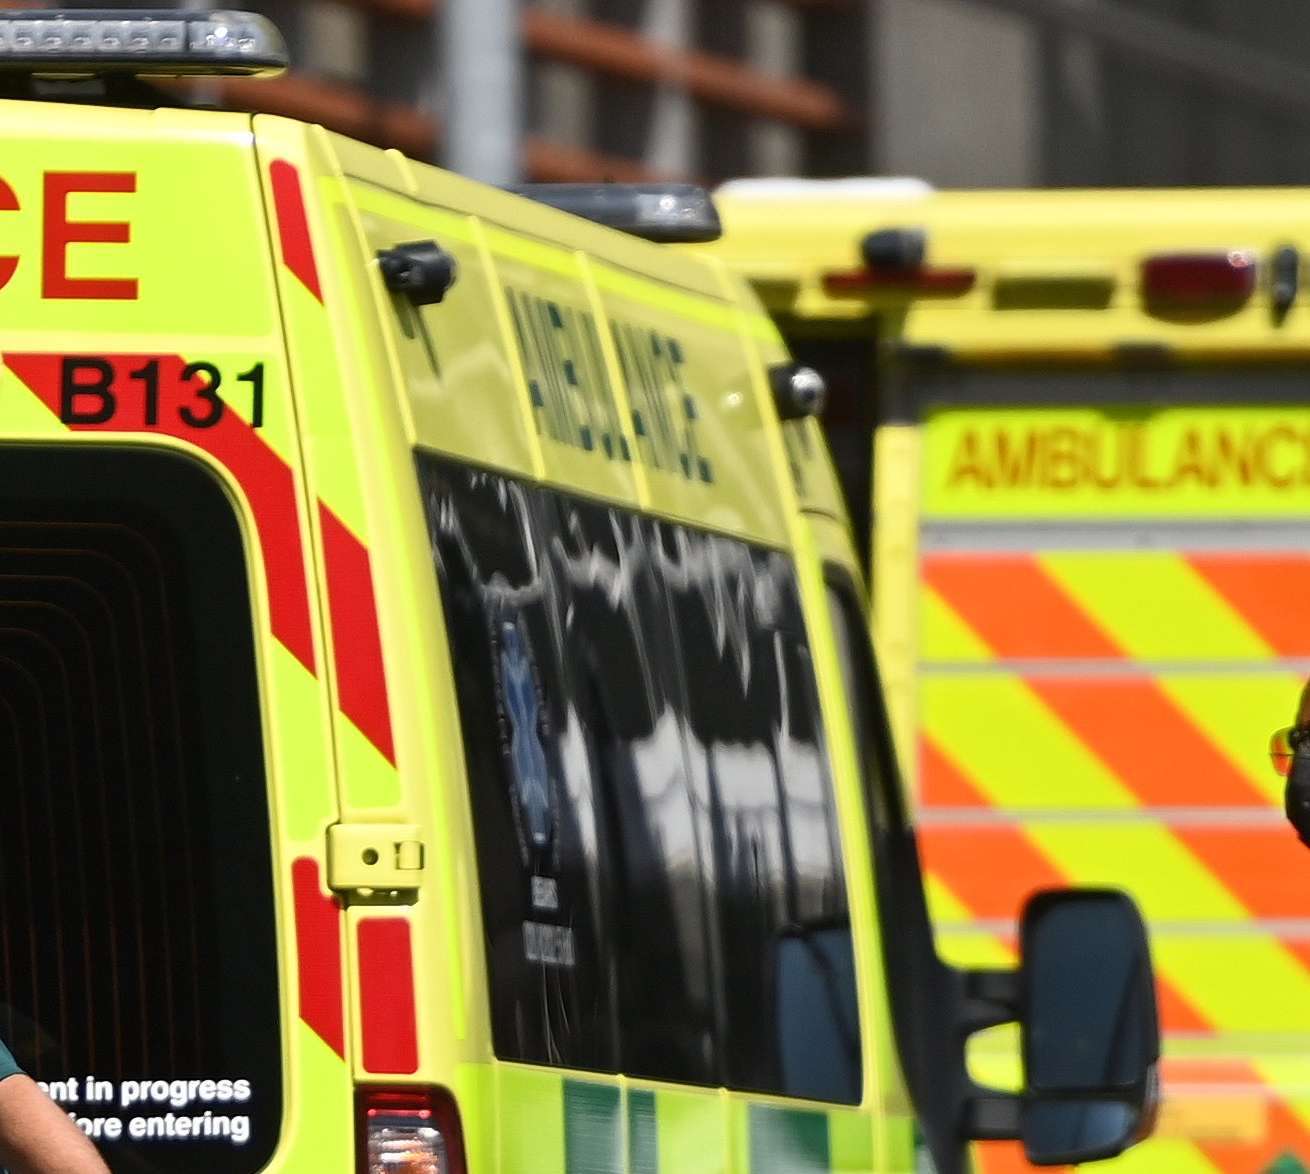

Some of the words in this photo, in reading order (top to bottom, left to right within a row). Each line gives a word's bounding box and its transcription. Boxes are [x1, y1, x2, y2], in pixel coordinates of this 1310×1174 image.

[60, 356, 265, 430] B131
[85, 1075, 114, 1101] in
[121, 1078, 251, 1108] progress
[128, 1110, 250, 1142] entering
